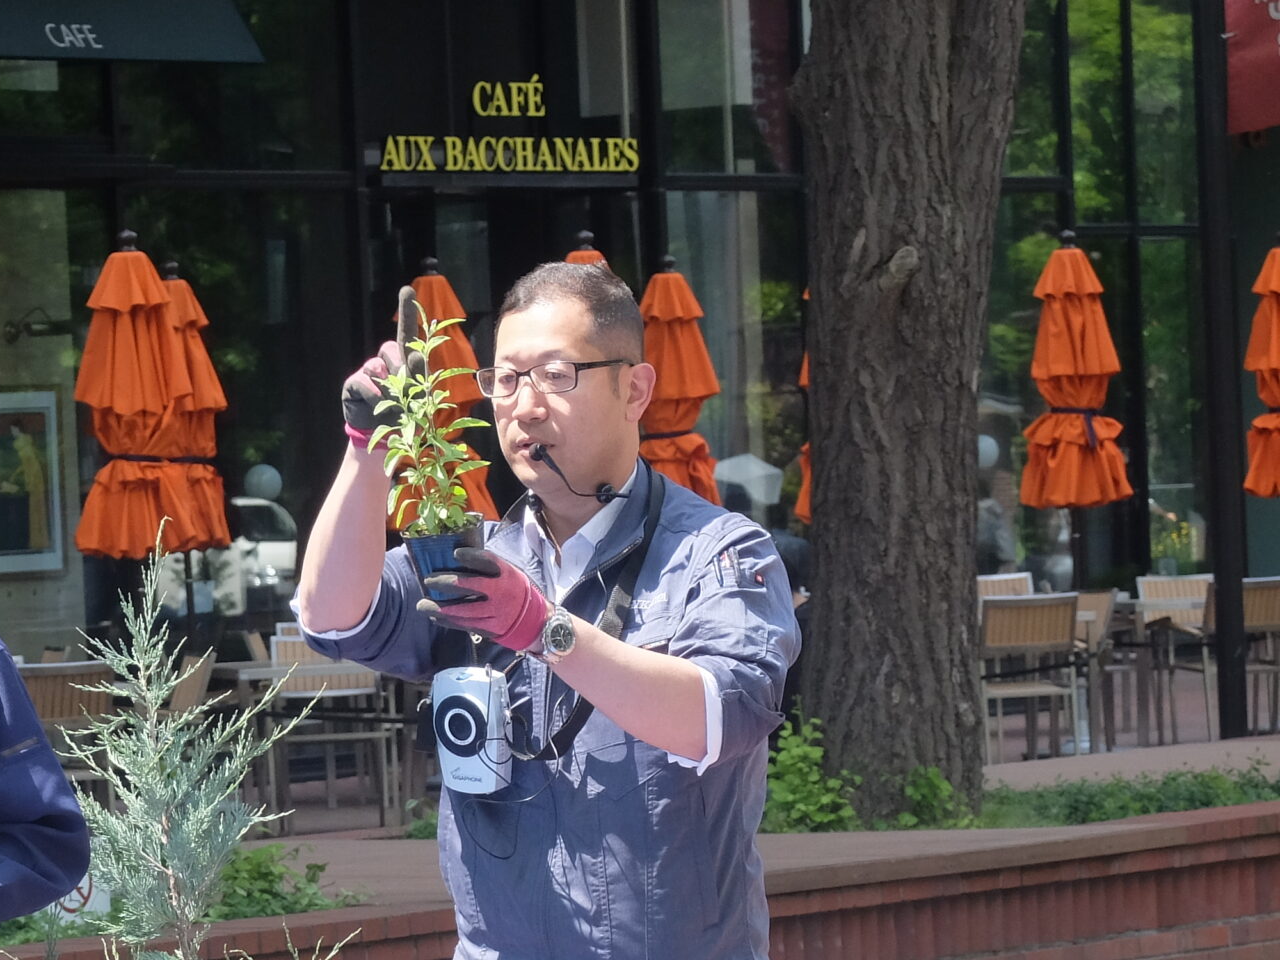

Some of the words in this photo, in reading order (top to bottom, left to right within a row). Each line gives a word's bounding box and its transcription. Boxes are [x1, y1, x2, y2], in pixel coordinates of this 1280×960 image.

[45, 23, 103, 48] CAFE
[472, 73, 546, 117] CAFÉ
[380, 135, 437, 171] AUX
[444, 136, 640, 172] BACCHANALES
